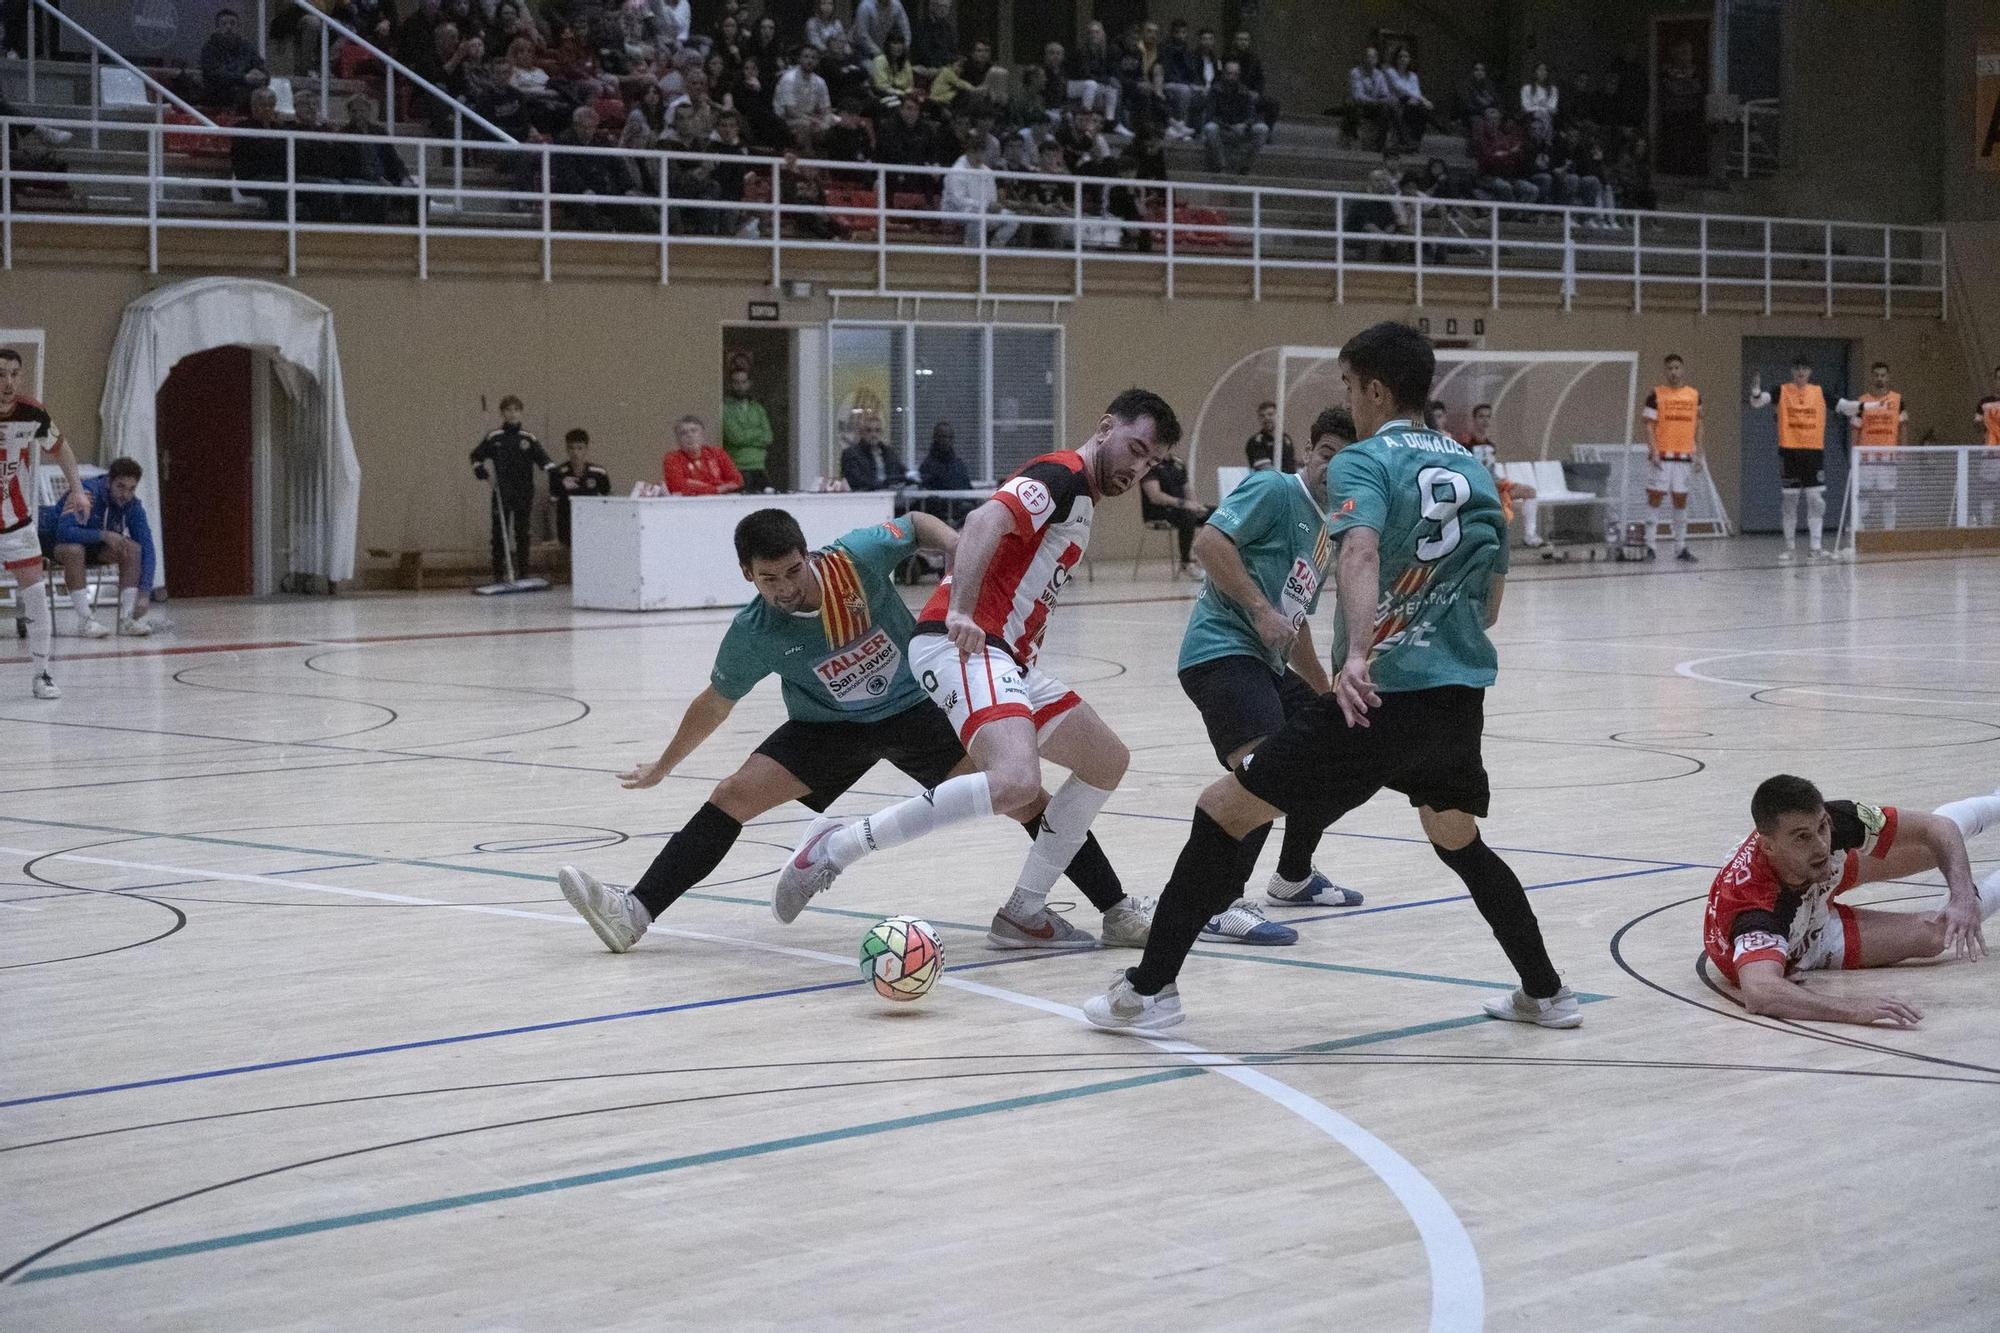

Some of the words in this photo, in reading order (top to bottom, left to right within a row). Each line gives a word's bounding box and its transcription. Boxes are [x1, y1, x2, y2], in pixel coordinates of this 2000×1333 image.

[1382, 435, 1404, 448] A.
[1416, 466, 1472, 563] 9
[817, 633, 889, 681] TALLER
[829, 672, 857, 692] San
[858, 643, 894, 675] Javier
